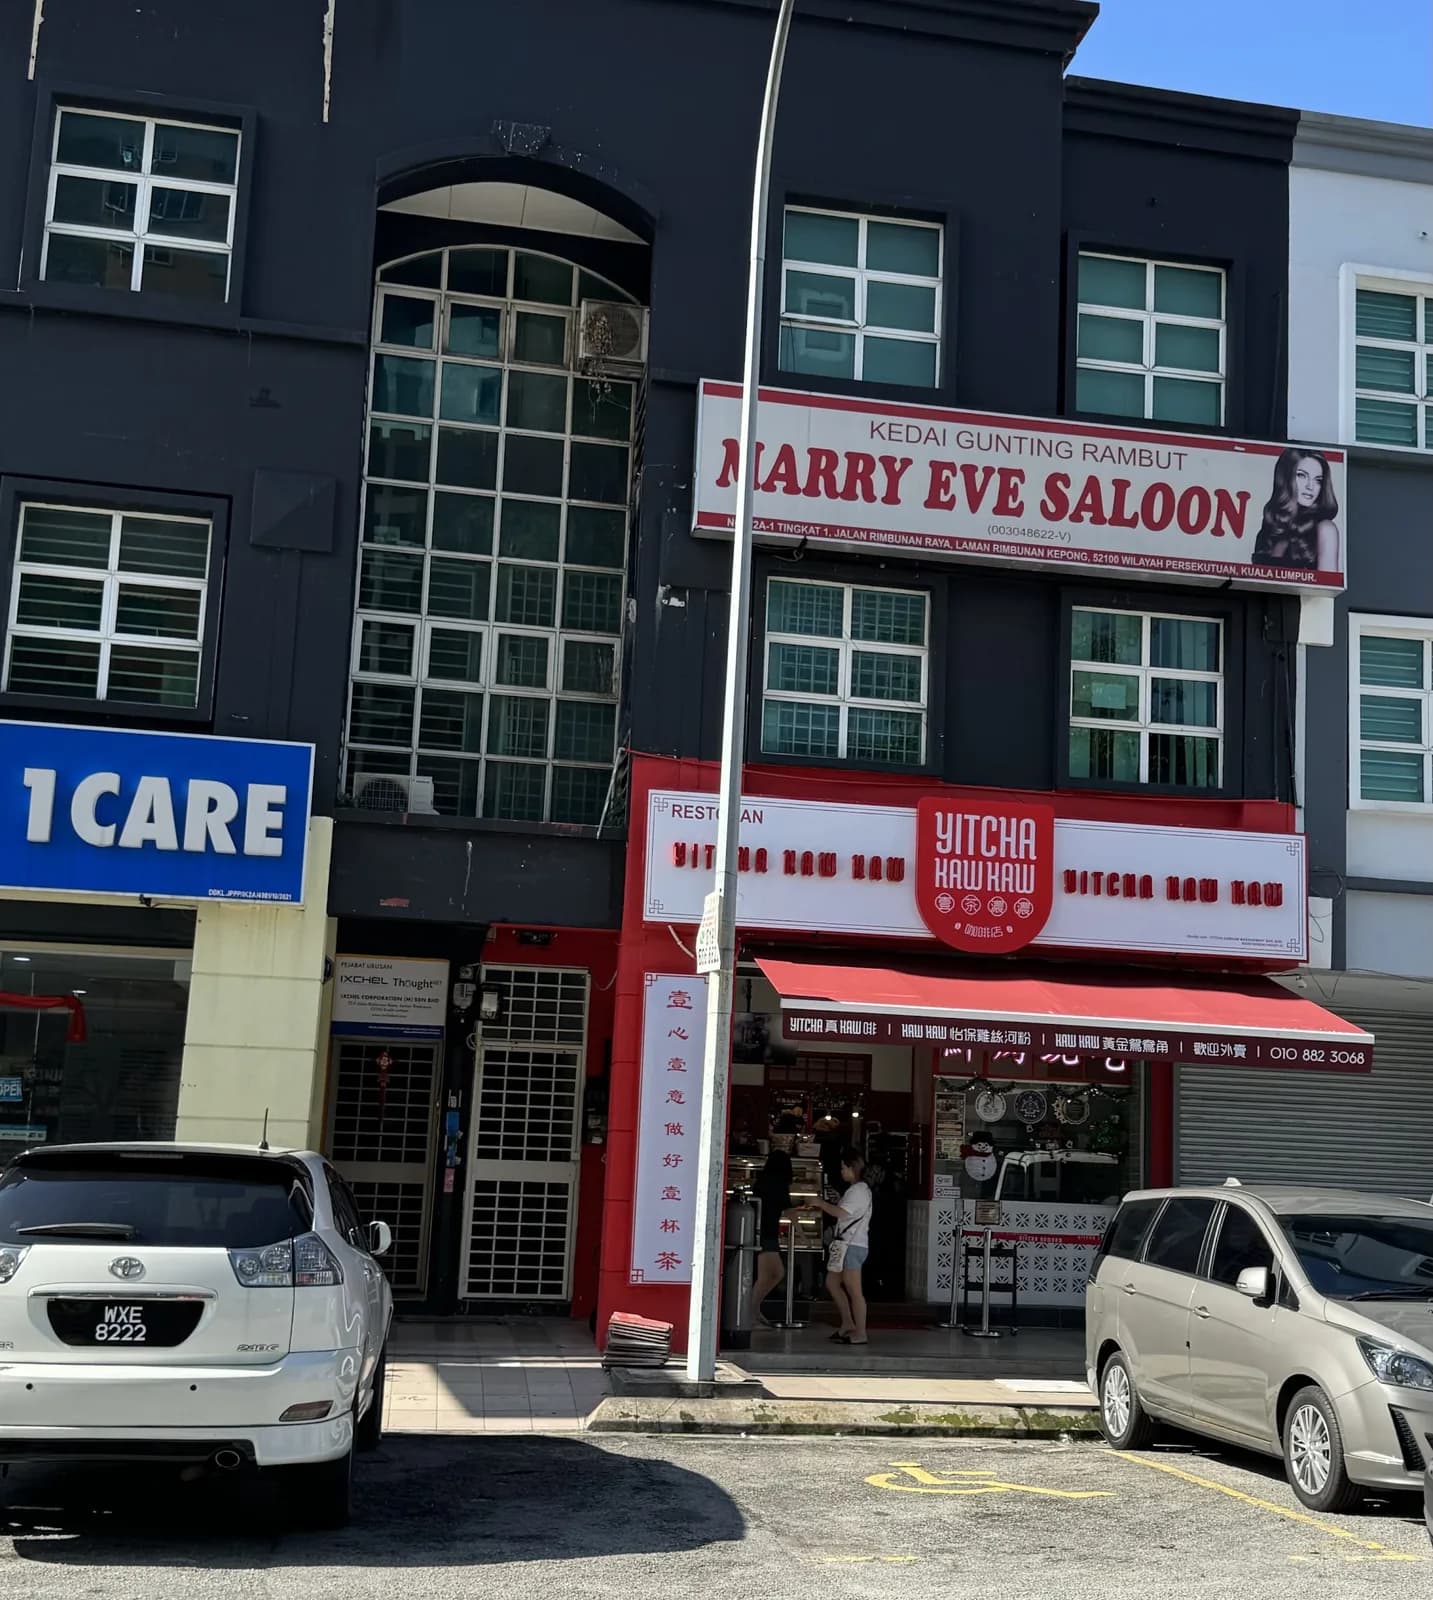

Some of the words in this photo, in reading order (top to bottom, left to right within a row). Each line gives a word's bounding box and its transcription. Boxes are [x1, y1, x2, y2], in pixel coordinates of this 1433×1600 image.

[870, 420, 947, 447] KEDAI
[956, 429, 1073, 459] GUNTING
[1082, 443, 1188, 470] RAMBUT
[715, 438, 913, 505] MARRY
[923, 460, 1026, 517] EVE
[1039, 472, 1252, 539] SALOON
[987, 525, 1072, 543] (003048622-V)
[777, 522, 821, 535] TINGKAT
[834, 530, 867, 541] JALAN
[869, 531, 922, 545] RIMBUNAN
[956, 541, 990, 552] LAMAN
[993, 544, 1044, 558] RIMBUNAN
[1047, 549, 1091, 563] KEPONG,
[1092, 553, 1119, 565] 52100
[1121, 555, 1164, 569] WILAYAH
[1240, 565, 1274, 579] KUALA
[1275, 569, 1317, 583] LUMPUR.
[671, 803, 764, 825] RESTAN
[935, 811, 1037, 861] YITCHA
[673, 841, 768, 874] YITHA
[783, 849, 837, 877] KAW
[852, 854, 905, 882] KAW
[934, 857, 983, 891] KAW
[986, 861, 1035, 894] KAW
[1063, 868, 1154, 899] YITCHA
[1166, 876, 1218, 903] KAW
[1231, 879, 1283, 907] KAW
[340, 975, 389, 985] IXCHEL
[789, 1016, 823, 1033] YITCHA
[901, 1023, 923, 1038] KAW
[925, 1024, 947, 1040] KAW
[1055, 1033, 1078, 1048] KAW
[1079, 1034, 1100, 1049] KAW
[1270, 1046, 1298, 1061] 010
[1302, 1048, 1326, 1063] 882
[1329, 1050, 1365, 1065] 3068
[104, 1305, 144, 1324] WXE
[95, 1323, 147, 1342] 8222
